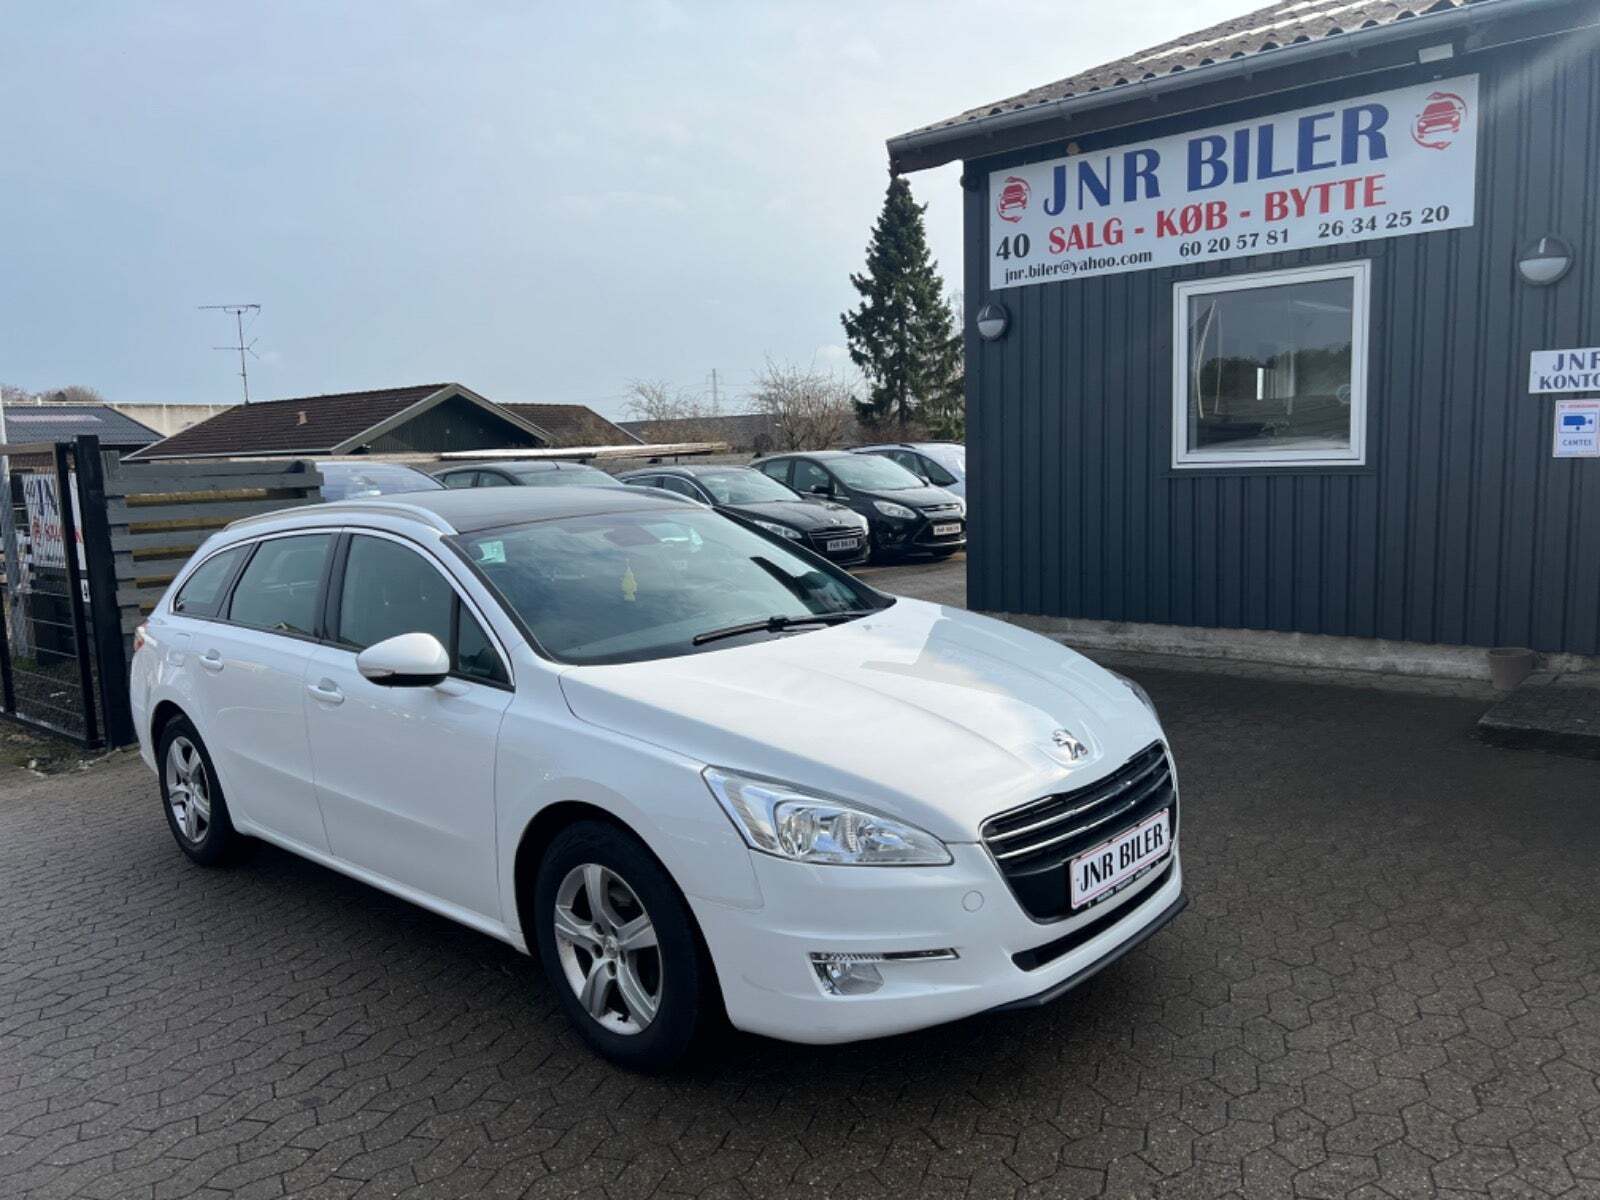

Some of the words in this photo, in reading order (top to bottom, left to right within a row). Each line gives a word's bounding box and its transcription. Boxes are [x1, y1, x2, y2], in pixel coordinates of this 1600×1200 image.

[1043, 147, 1161, 217] JNR
[1186, 102, 1390, 192] BILER
[1048, 216, 1124, 255] SALG
[1156, 200, 1228, 239] KØB
[1264, 173, 1388, 222] BYTTE
[1317, 220, 1345, 239] 26
[1350, 214, 1377, 234] 34
[1384, 210, 1413, 229] 25
[1420, 204, 1450, 225] 20
[995, 232, 1031, 261] 40
[1178, 238, 1203, 257] 60
[1207, 236, 1232, 254] 20
[1236, 233, 1259, 251] 57
[1265, 228, 1290, 246] 81
[1003, 248, 1154, 284] jnr.biler@yahoo.com
[1080, 852, 1114, 892] JNR
[1119, 823, 1164, 868] BILER
